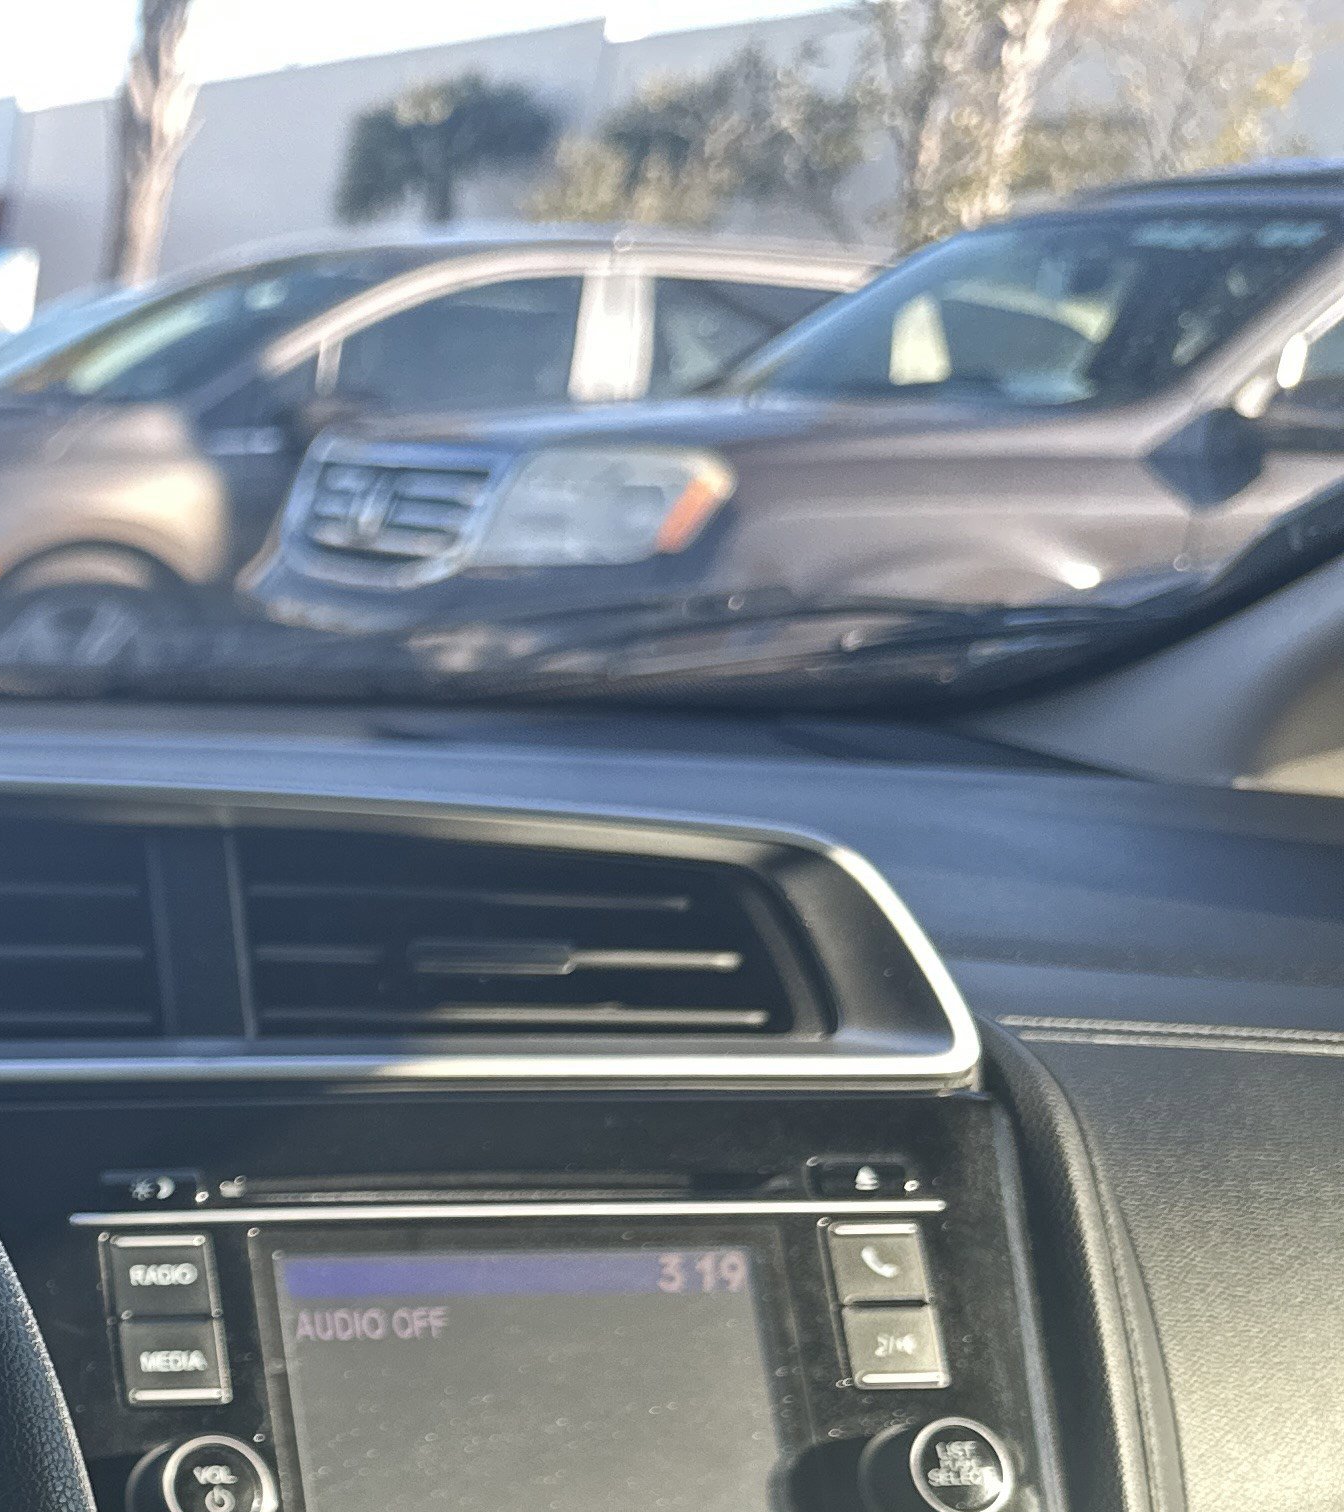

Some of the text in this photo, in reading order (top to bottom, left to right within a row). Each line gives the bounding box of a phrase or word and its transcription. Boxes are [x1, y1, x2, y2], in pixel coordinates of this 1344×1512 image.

[129, 1263, 198, 1286] RADIO
[296, 1306, 450, 1341] AUDIO OFF
[140, 1350, 208, 1373] MEDIA
[193, 1465, 238, 1485] VOL
